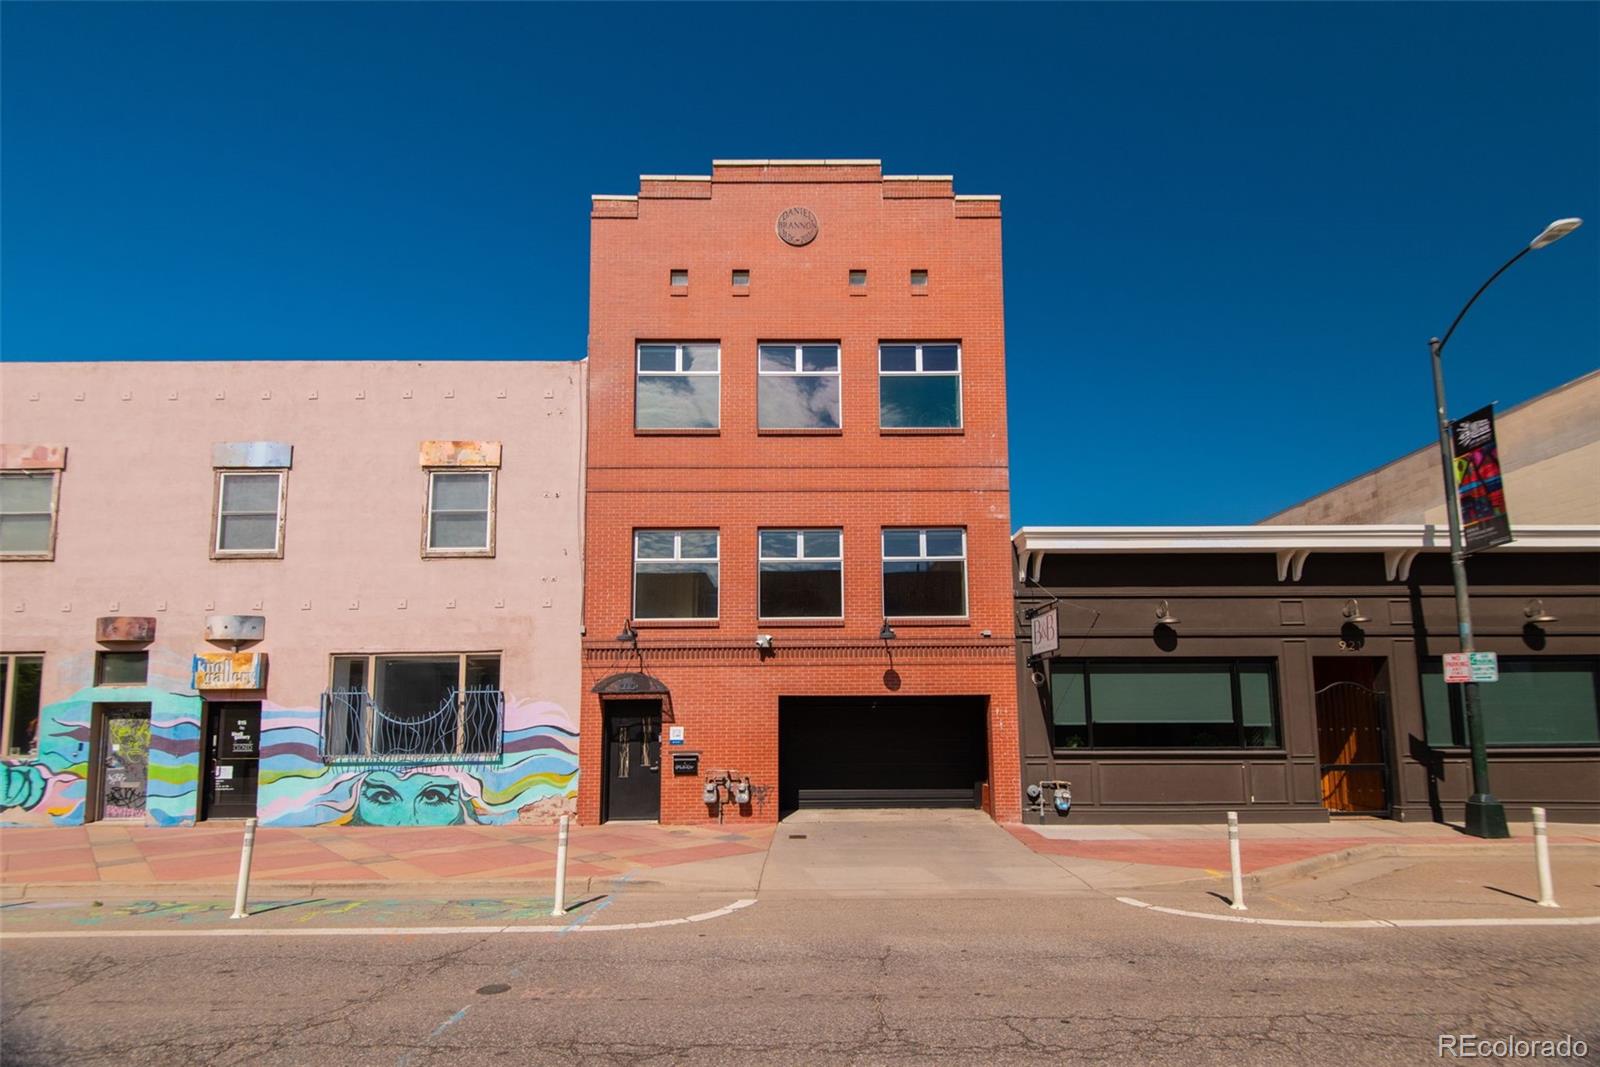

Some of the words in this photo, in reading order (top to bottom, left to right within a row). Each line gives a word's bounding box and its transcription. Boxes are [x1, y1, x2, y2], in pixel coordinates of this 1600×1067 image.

[1033, 614, 1055, 646] B&B
[197, 658, 231, 673] knoll
[204, 669, 257, 687] gallery
